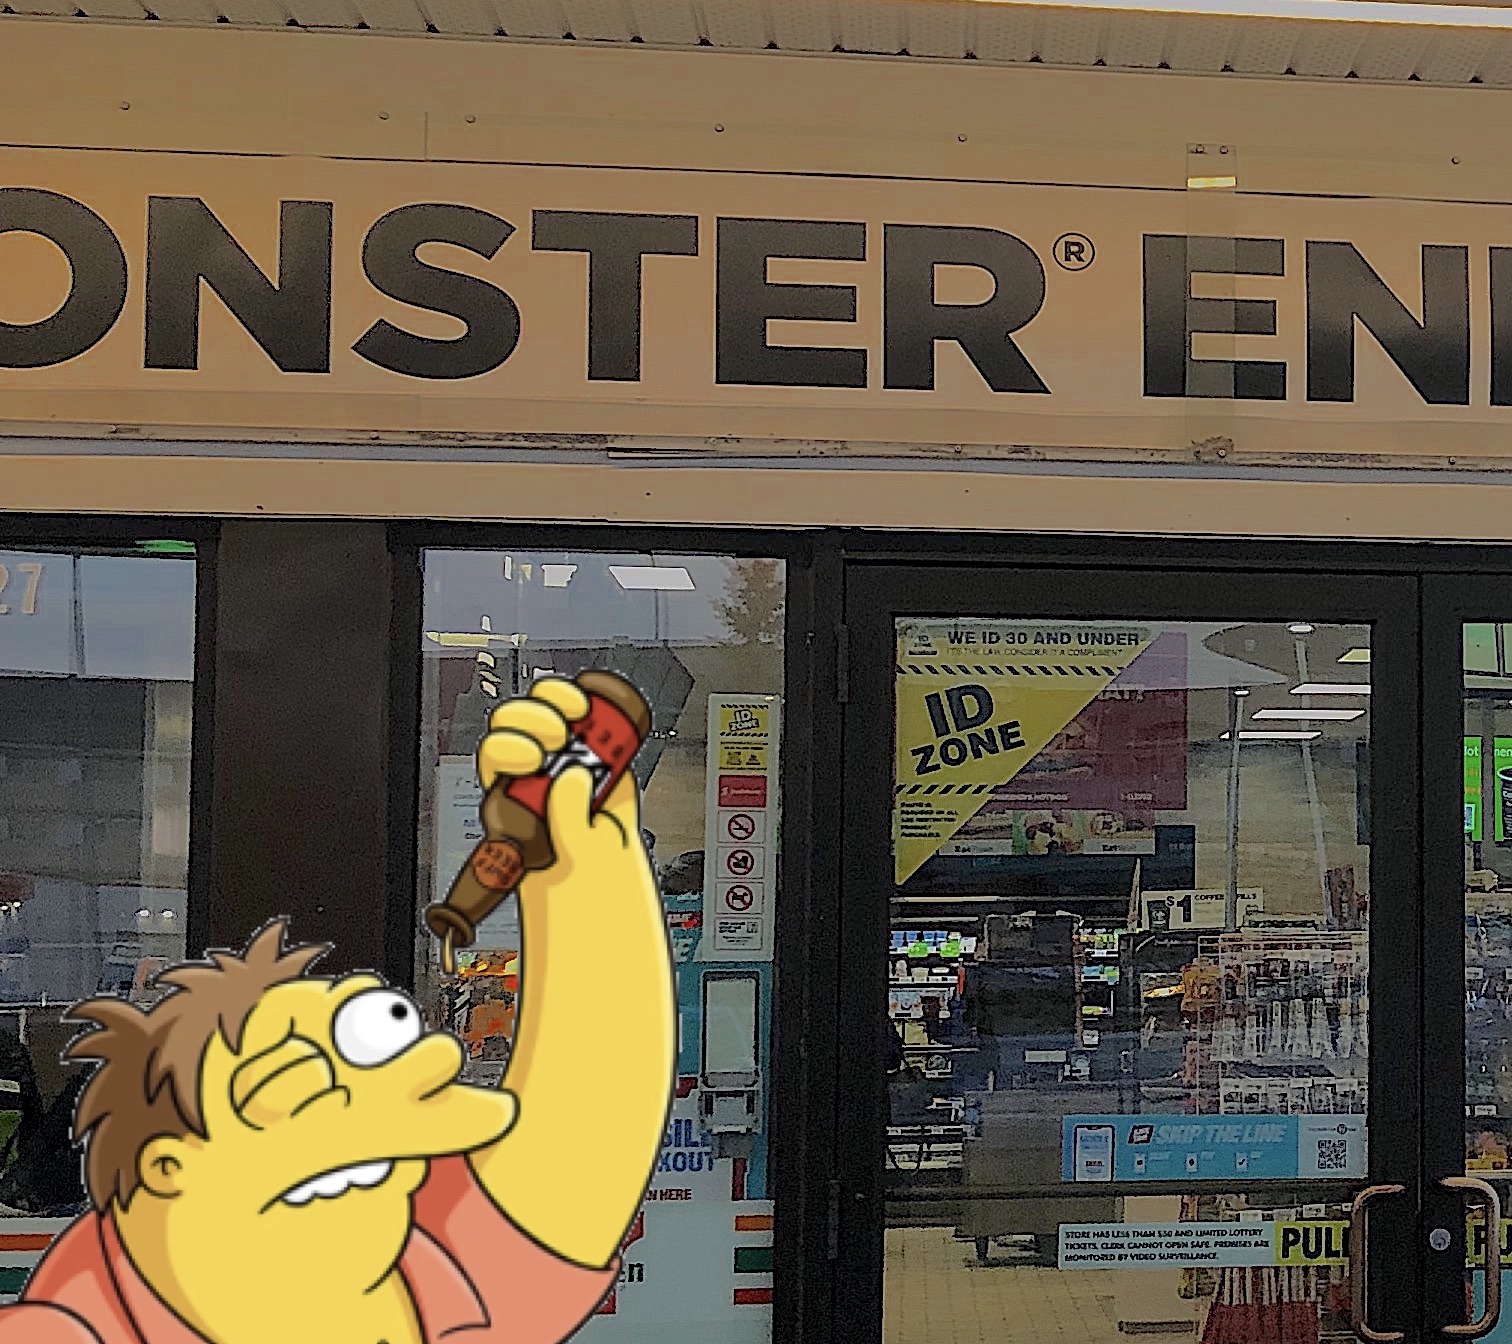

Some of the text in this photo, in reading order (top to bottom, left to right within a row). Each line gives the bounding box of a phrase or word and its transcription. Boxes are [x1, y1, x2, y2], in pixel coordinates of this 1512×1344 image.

[948, 631, 1139, 646] WE ID 30 AND UNDER
[924, 684, 994, 739] ID
[911, 720, 1026, 776] ZONE
